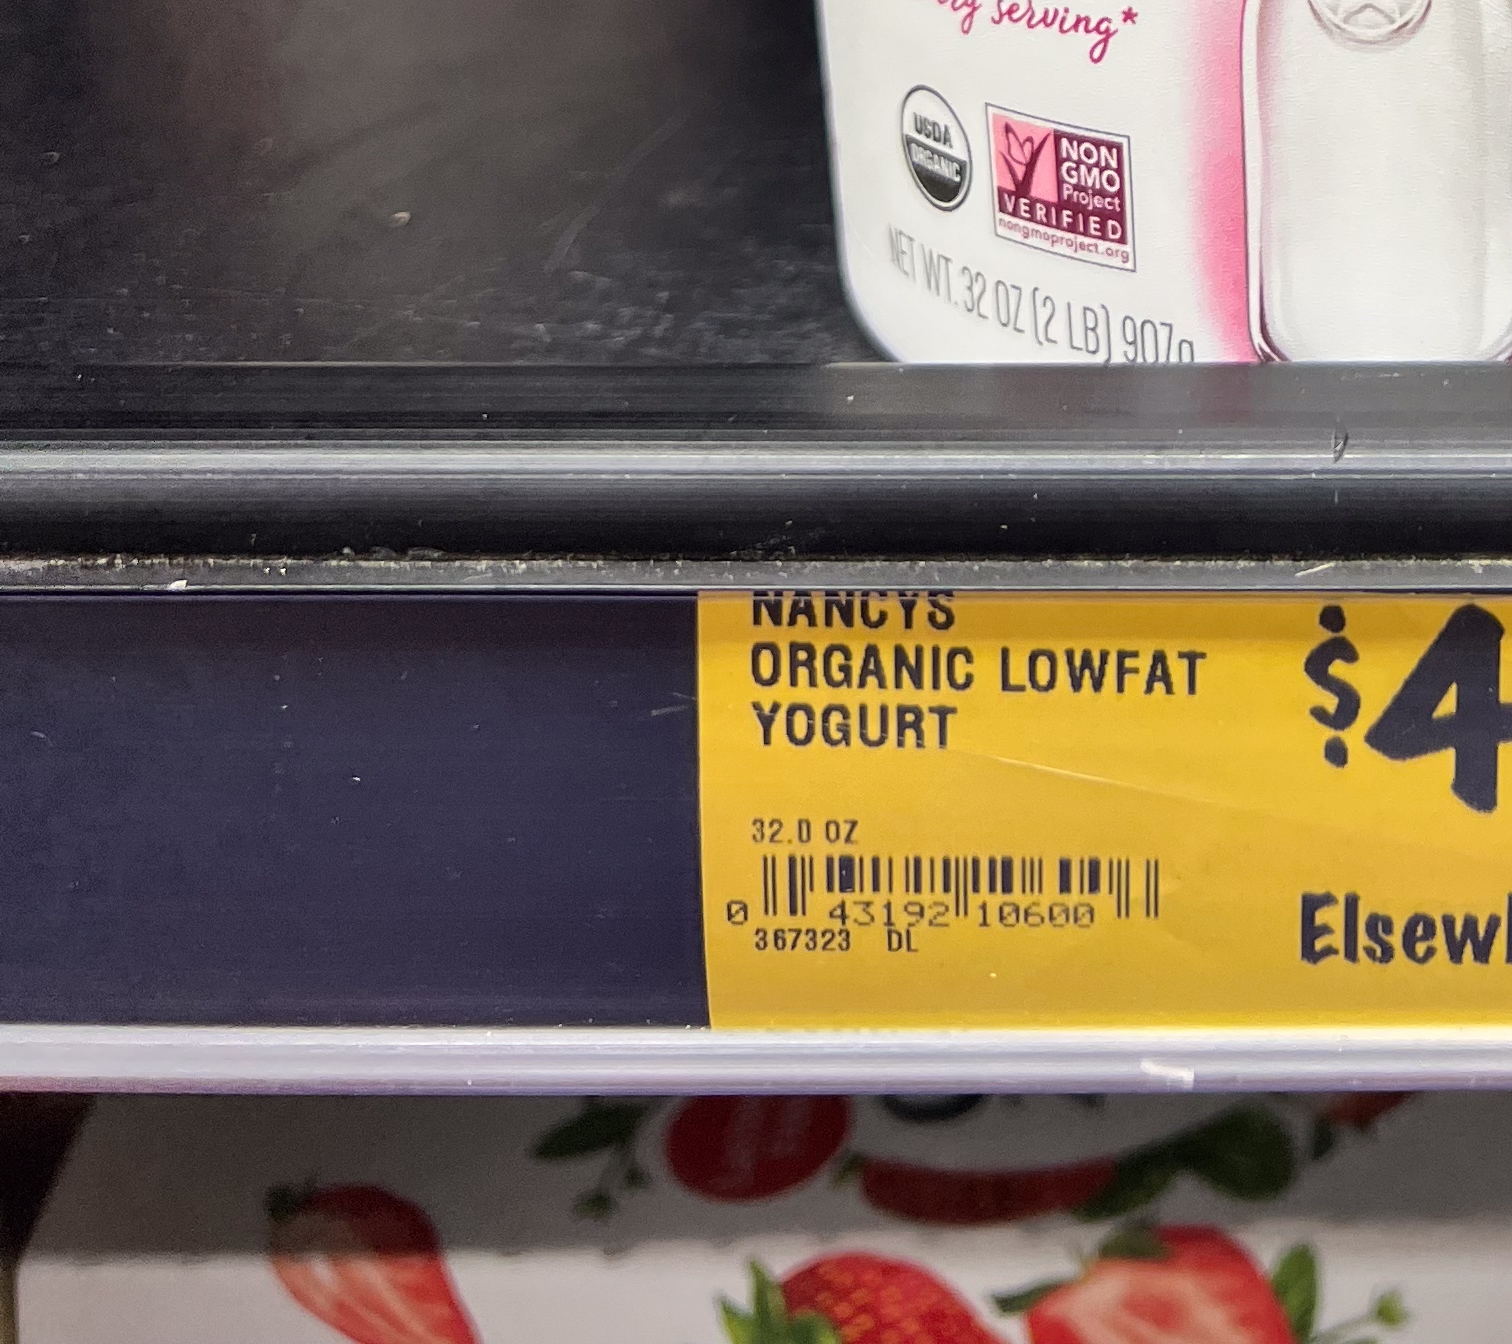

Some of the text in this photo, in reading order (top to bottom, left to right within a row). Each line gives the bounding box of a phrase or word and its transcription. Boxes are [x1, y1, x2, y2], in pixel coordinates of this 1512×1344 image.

[912, 111, 955, 150] USDA
[909, 142, 962, 184] ORGANIC
[1059, 137, 1119, 170] NON
[1060, 163, 1122, 194] GMO
[1062, 183, 1122, 213] Project
[1002, 192, 1123, 241] VERIFIED
[998, 216, 1131, 264] nongmoproject.org
[887, 223, 917, 285] NET
[960, 265, 990, 321] 32
[994, 279, 1026, 334] OZ
[1032, 286, 1058, 347] (2
[1066, 300, 1113, 363] LB)
[752, 590, 956, 631] NANCYS
[751, 642, 1208, 697] ORGANIC LOWFAT
[752, 701, 959, 750] YOGURT
[824, 819, 860, 846] OZ
[726, 900, 1096, 930] 0 43192 10600
[754, 928, 920, 955] 367323 DL
